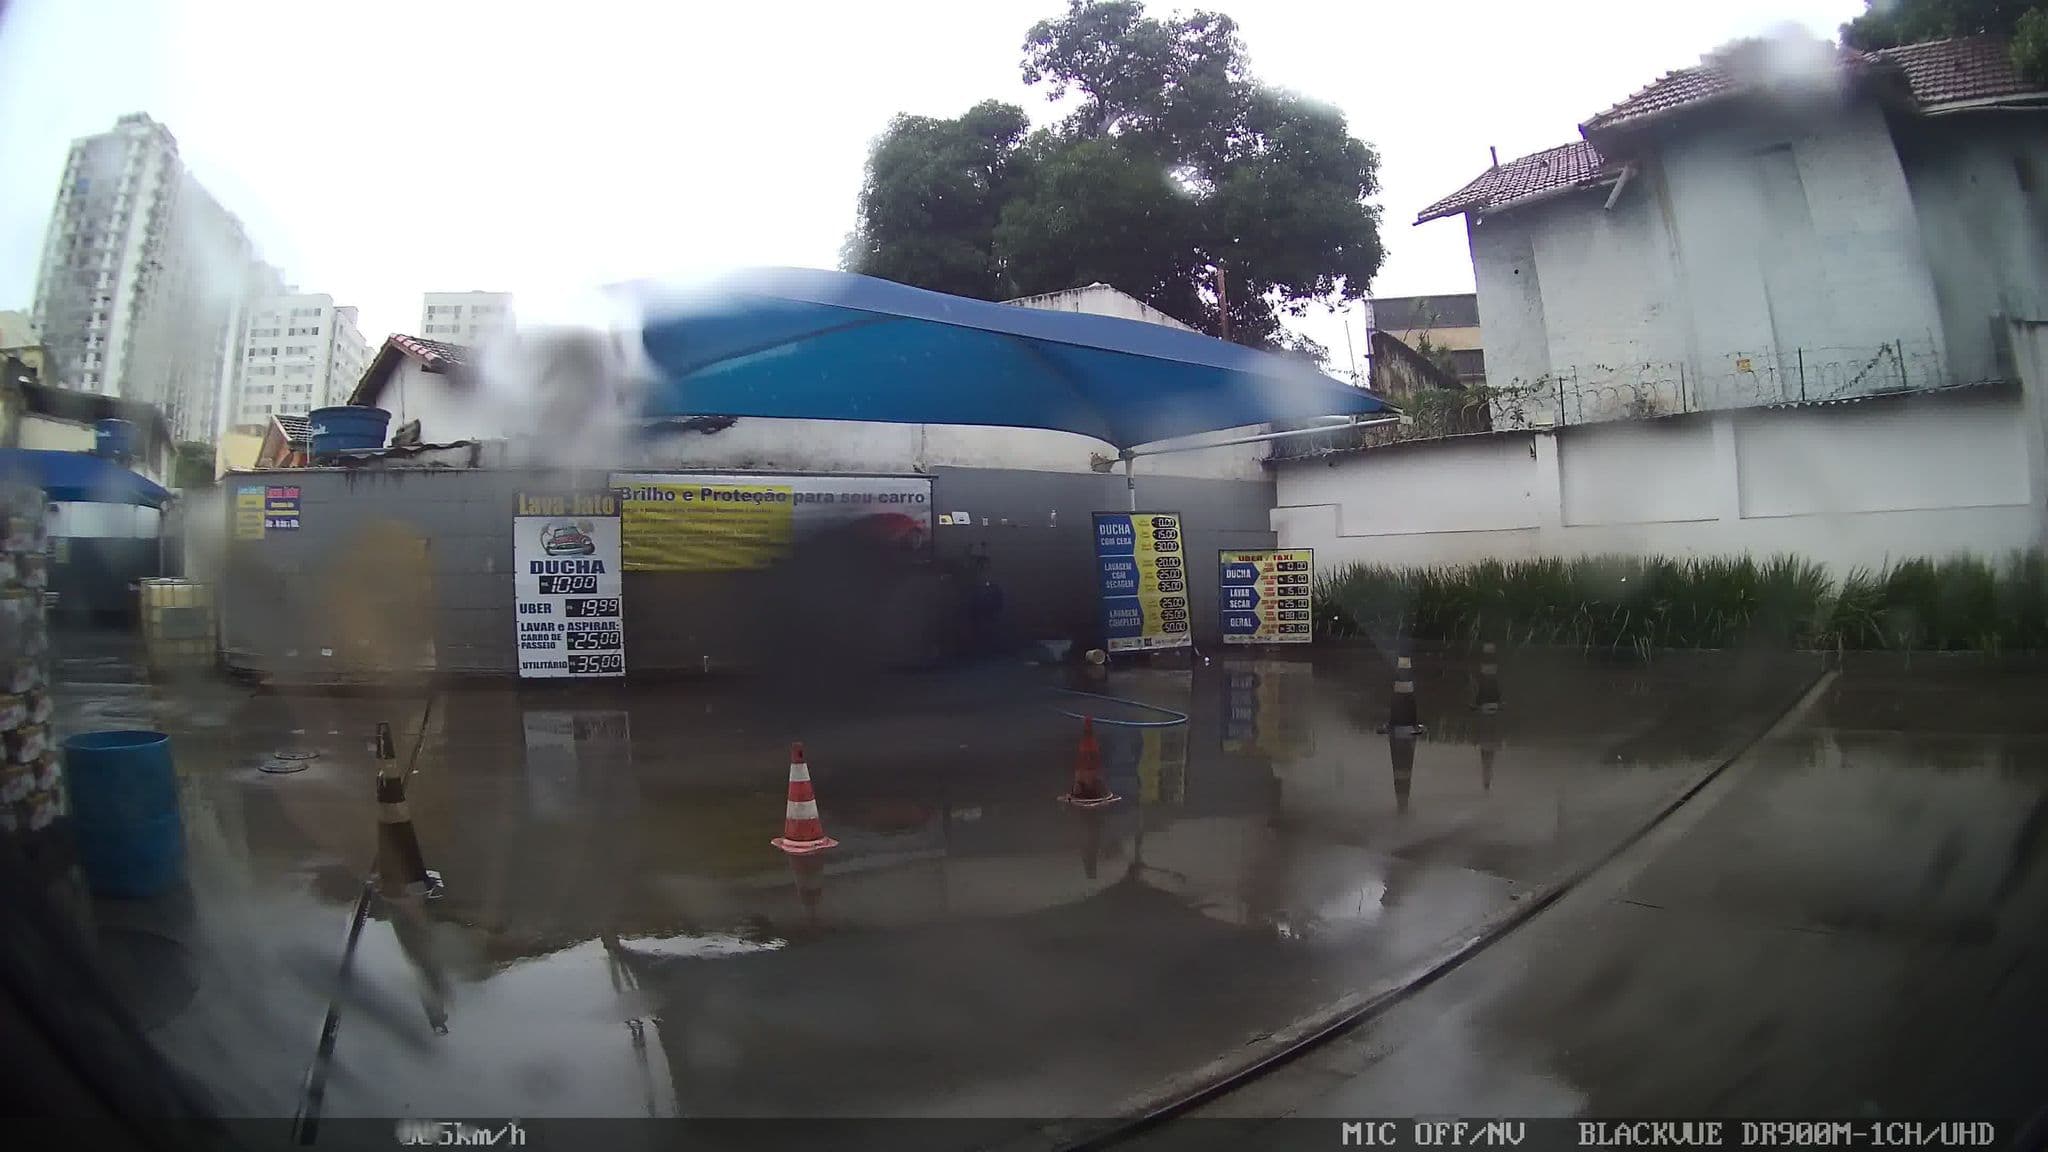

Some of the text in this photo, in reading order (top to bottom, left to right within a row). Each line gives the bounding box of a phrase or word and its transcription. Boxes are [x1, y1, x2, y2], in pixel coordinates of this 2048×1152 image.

[622, 486, 676, 501] Brilho
[682, 489, 694, 502] e
[701, 487, 787, 506] Proteção
[793, 492, 835, 506] para
[878, 492, 925, 504] carro
[1099, 523, 1131, 535] DUCHA
[530, 560, 606, 575] DUCHA
[1226, 569, 1252, 579] DUCHA
[551, 576, 596, 593] 10.00
[519, 603, 552, 614] UBER
[581, 599, 618, 617] 19.99
[520, 622, 555, 632] LAVAR
[557, 624, 565, 632] e
[1230, 617, 1253, 628] GERAL
[520, 633, 550, 641] CARRO
[551, 633, 562, 641] DE
[575, 631, 620, 649] 25.00
[521, 642, 556, 650] PASSEIO
[577, 655, 621, 673] 35.00
